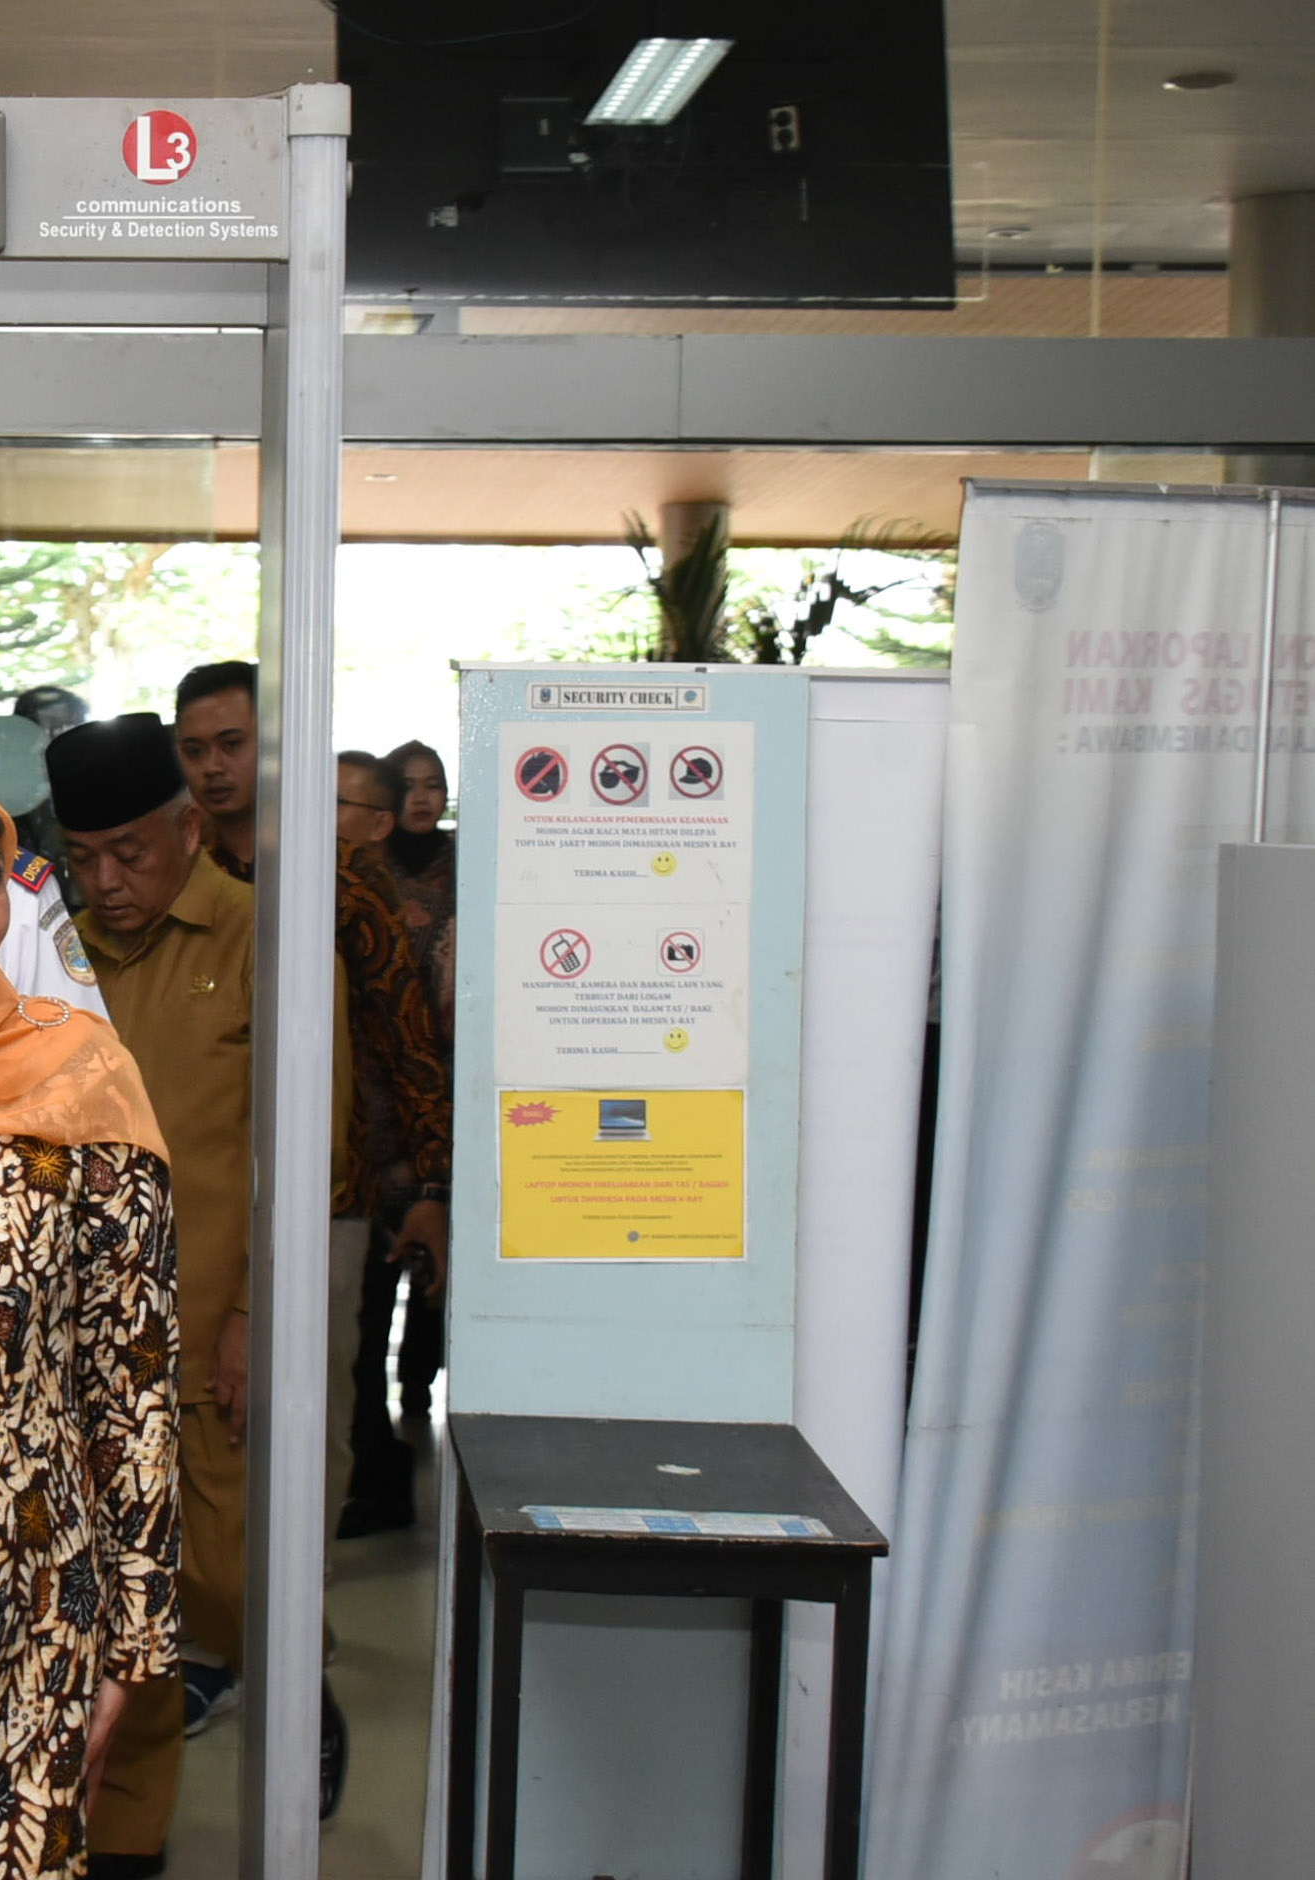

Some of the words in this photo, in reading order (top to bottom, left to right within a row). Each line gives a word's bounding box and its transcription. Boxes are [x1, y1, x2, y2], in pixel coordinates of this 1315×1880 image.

[137, 116, 191, 180] L3
[76, 197, 241, 213] communications
[39, 221, 106, 241] Security
[111, 222, 123, 238] &
[128, 222, 204, 238] Detection
[209, 222, 279, 241] Systems
[563, 690, 626, 704] SECURITY
[630, 692, 674, 705] CHECK
[616, 816, 677, 824] PEMERIKSAAN
[536, 827, 568, 835] MOHON
[571, 827, 594, 835] AGAR
[597, 827, 619, 835] KACA
[621, 828, 646, 836] MATA
[649, 828, 678, 836] HITAM
[681, 828, 716, 836] DILEPAS
[623, 840, 681, 848] DIMASUKKAN
[683, 840, 711, 848] MESIN
[575, 869, 607, 877] TERIMA
[581, 981, 617, 989] KAMERA
[620, 981, 638, 989] DAN
[640, 981, 675, 989] BARANG
[678, 981, 698, 989] LAIN
[700, 981, 723, 989] YANG
[575, 993, 615, 1001] TERBUAT
[617, 993, 638, 1001] DARI
[640, 993, 671, 1001] LOGAM
[633, 1005, 664, 1013] DALAM
[666, 1005, 682, 1013] TAS
[556, 1047, 589, 1055] TERIMA
